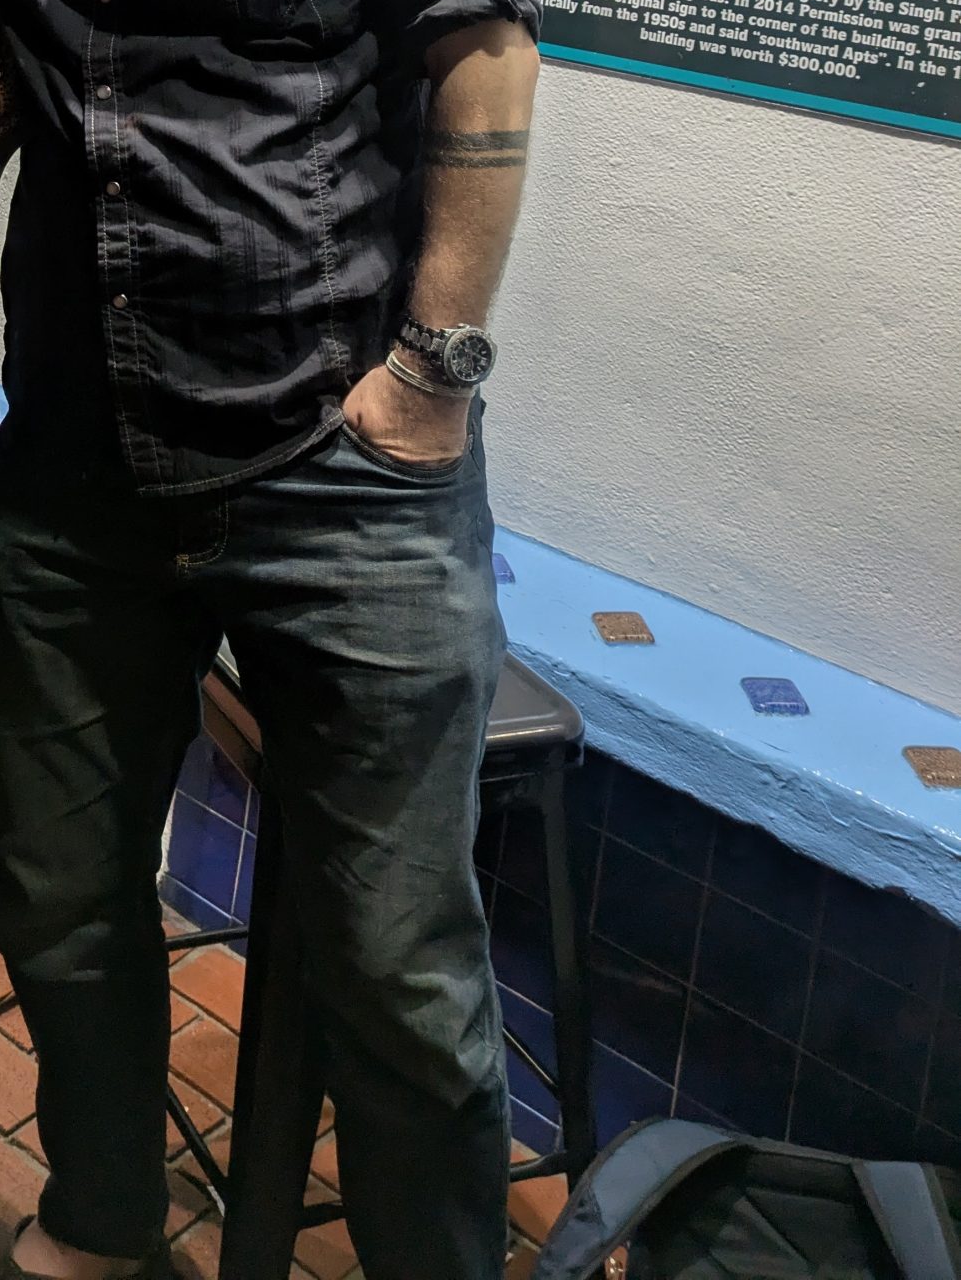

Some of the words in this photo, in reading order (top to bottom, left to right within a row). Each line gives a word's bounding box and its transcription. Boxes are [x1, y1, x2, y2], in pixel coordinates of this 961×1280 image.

[581, 0, 613, 17] from
[616, 7, 638, 22] the
[643, 11, 686, 30] 1950s
[688, 22, 715, 35] and
[718, 27, 748, 41] said
[897, 55, 914, 71] In
[918, 60, 946, 76] the
[667, 0, 697, 17] sign
[701, 5, 716, 18] to
[720, 8, 744, 23] the
[748, 15, 797, 32] corner
[800, 23, 819, 36] of
[821, 25, 847, 41] the
[851, 30, 921, 56] building.
[798, 3, 883, 29] Permission
[888, 20, 919, 35] was
[898, 1, 944, 23] Singh
[639, 27, 695, 51] building
[699, 40, 726, 54] was
[730, 46, 774, 63] worth
[778, 51, 860, 79] $300,000.
